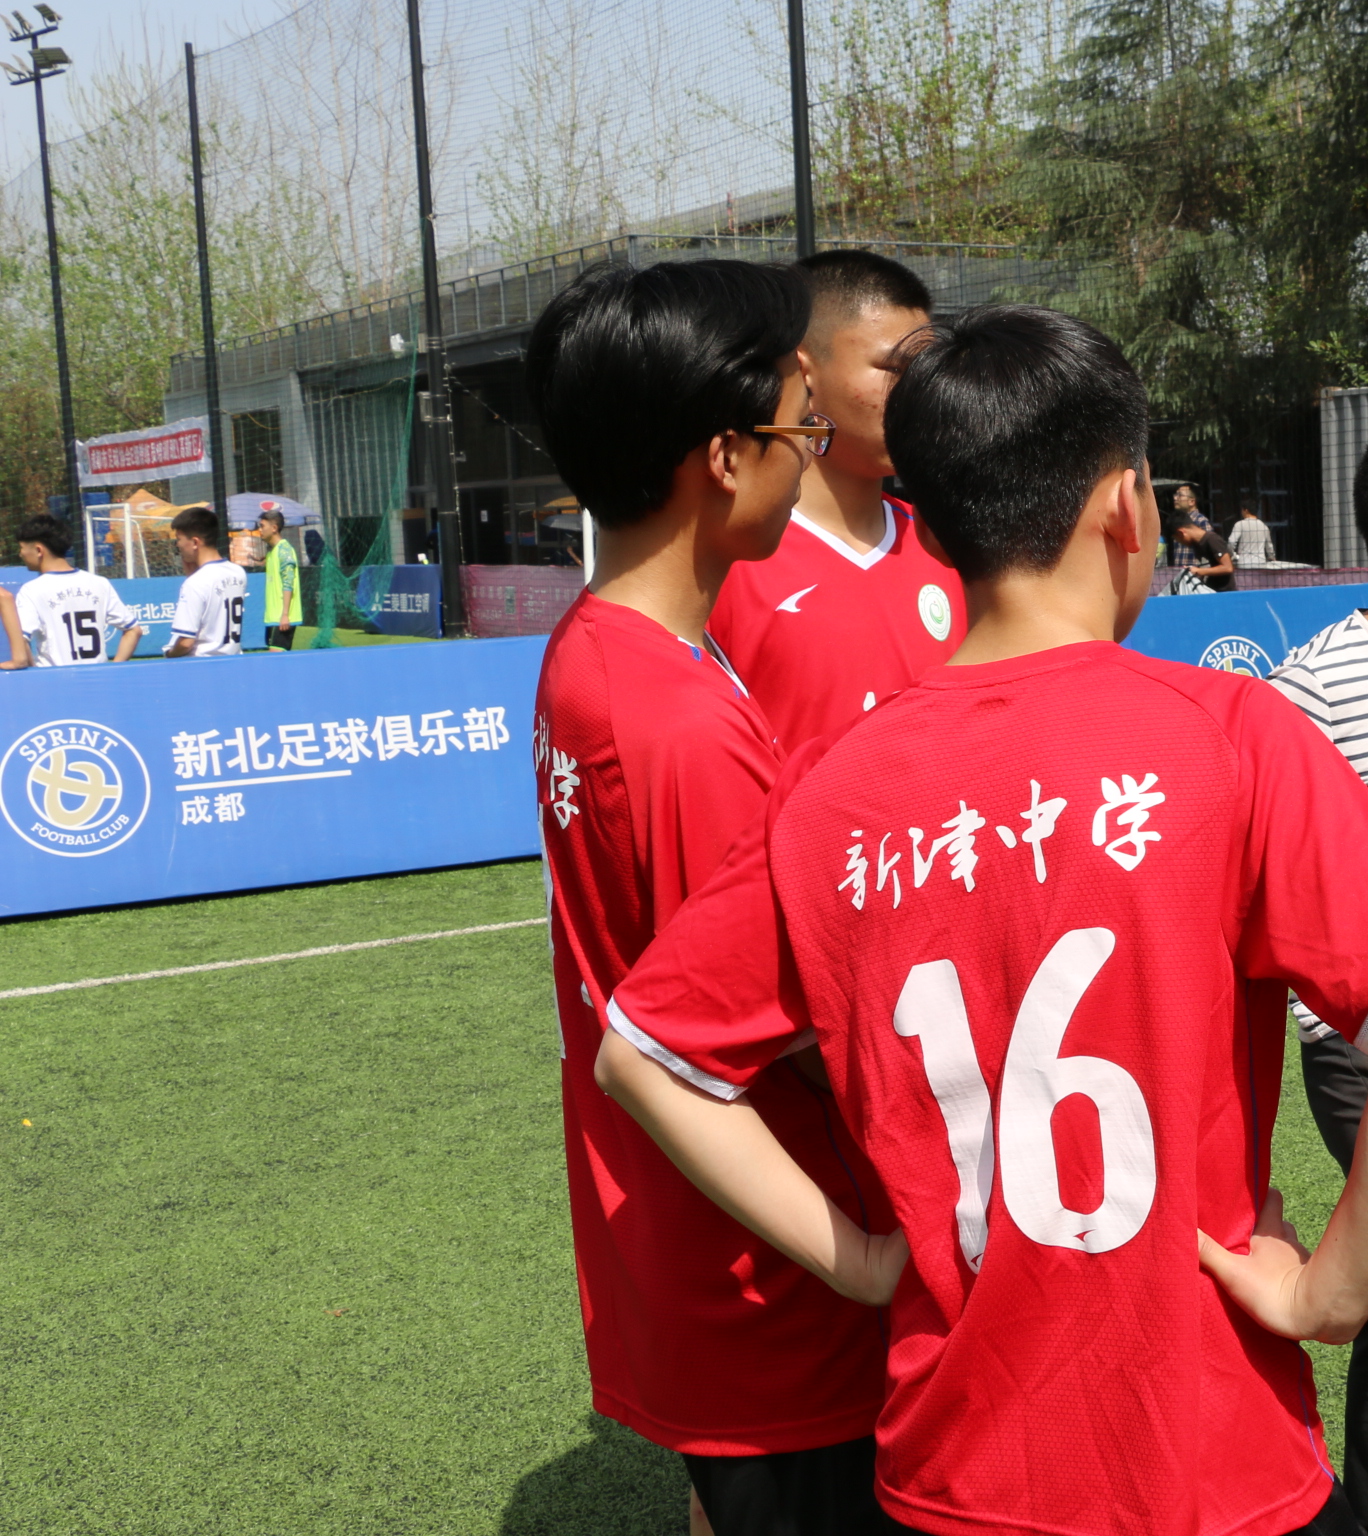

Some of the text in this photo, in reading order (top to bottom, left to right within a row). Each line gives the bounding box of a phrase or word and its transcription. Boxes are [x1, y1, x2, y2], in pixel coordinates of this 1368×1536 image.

[61, 610, 101, 660] 15
[224, 596, 244, 645] 19
[1206, 641, 1260, 667] SPRINT
[19, 727, 118, 762] SPRINT
[171, 706, 510, 779] 新北足球俱乐部
[30, 814, 130, 846] FOOTBALL CLUB
[181, 792, 246, 825] 成都
[837, 772, 1166, 911] 新津中学
[892, 926, 1158, 1275] 16
